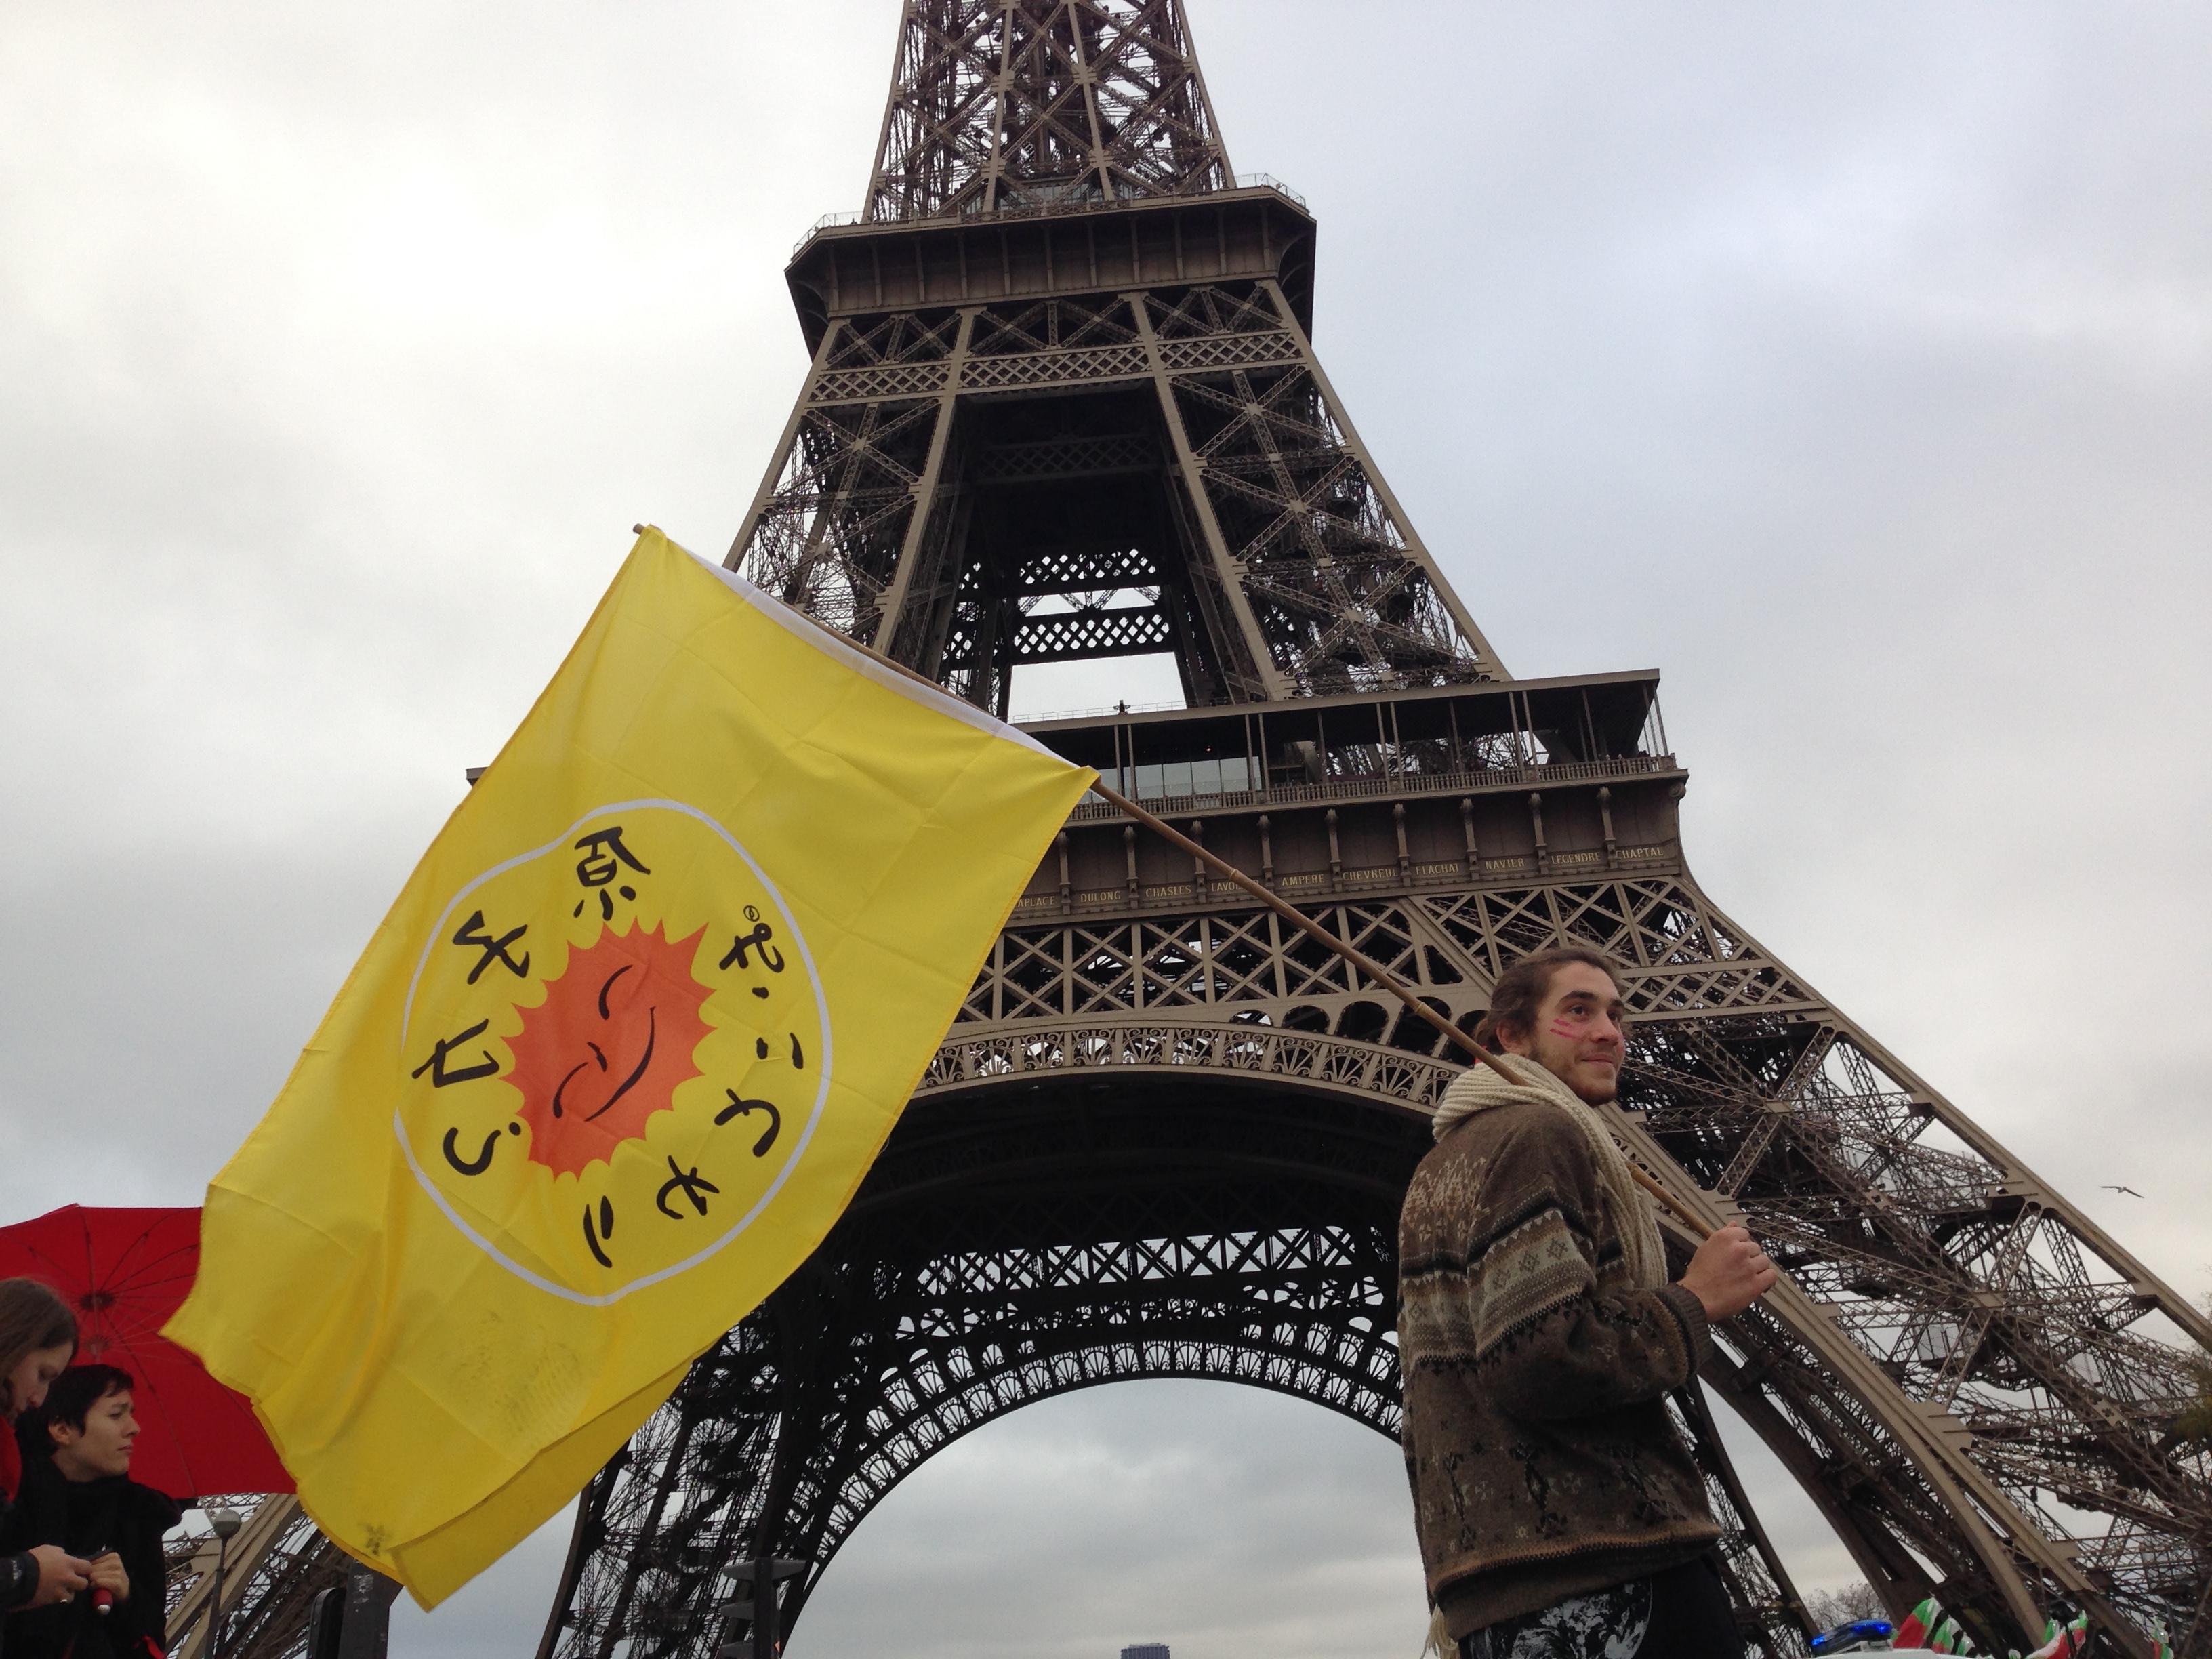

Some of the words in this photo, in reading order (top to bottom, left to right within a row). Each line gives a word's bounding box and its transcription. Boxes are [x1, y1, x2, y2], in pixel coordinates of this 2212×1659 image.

[1551, 851, 1601, 865] LEGENDRE
[1616, 847, 1664, 859] CHAPTAL
[1416, 863, 1459, 876] FLACHAT
[1485, 858, 1525, 870] NAVIER
[1282, 874, 1325, 886] AMPERE
[1343, 868, 1398, 881] CHEVREUL
[1080, 890, 1121, 903] DULONG
[1145, 884, 1192, 897] CHASLES
[1017, 895, 1055, 907] APLACE
